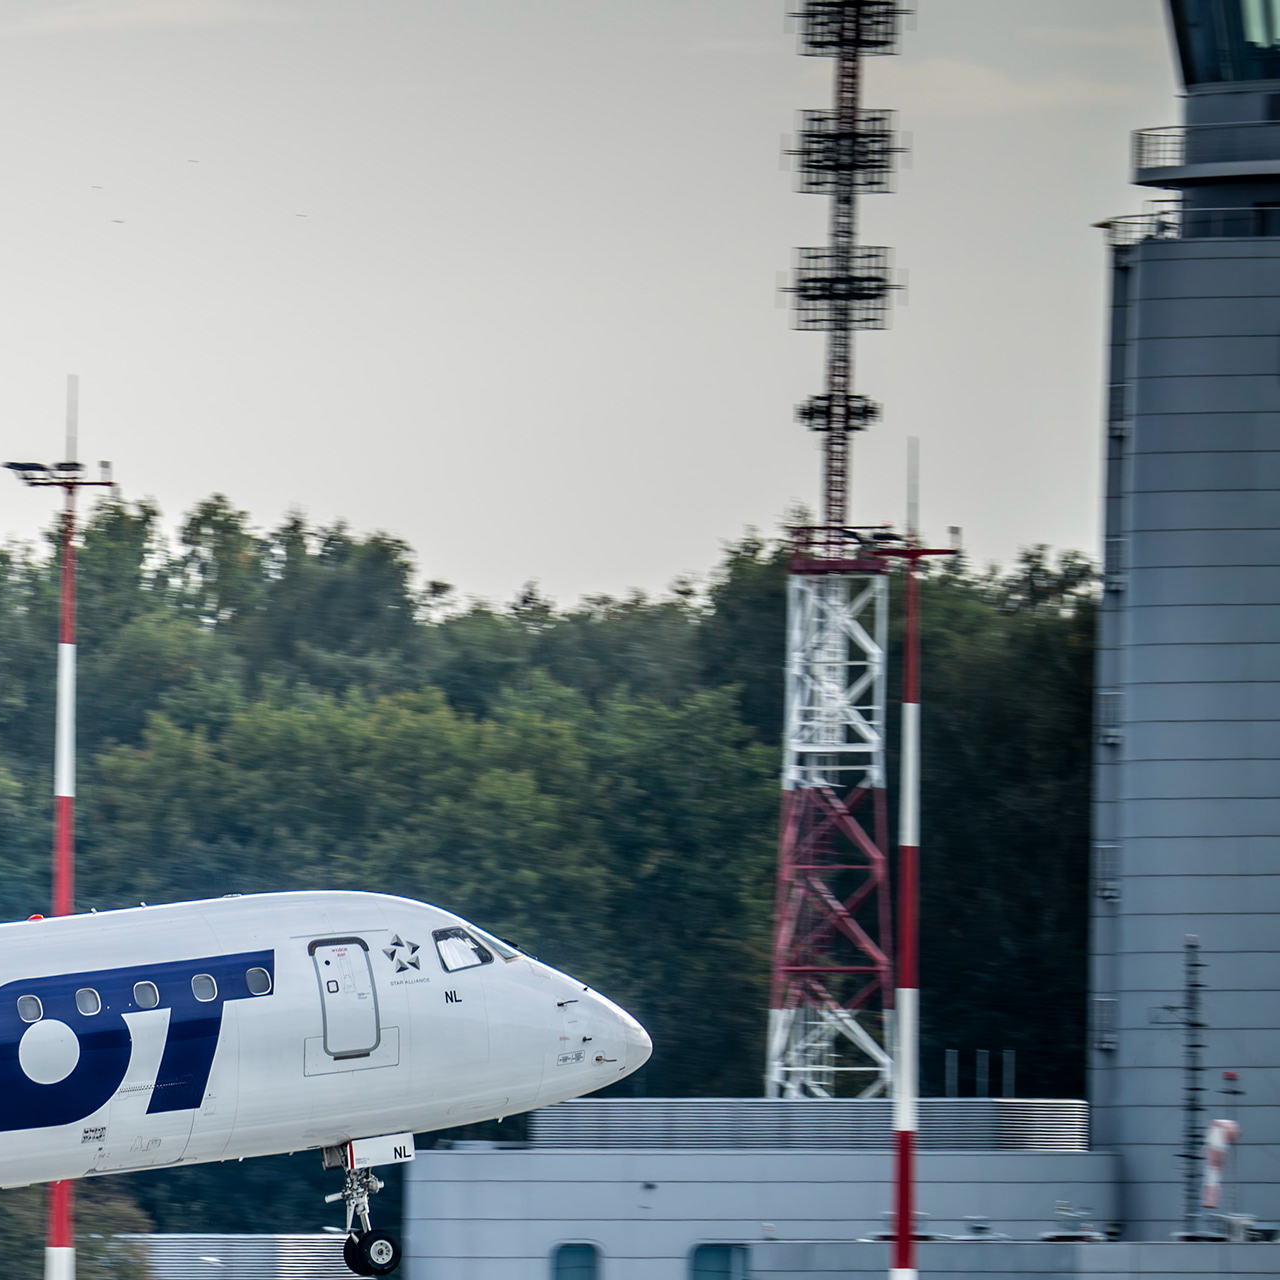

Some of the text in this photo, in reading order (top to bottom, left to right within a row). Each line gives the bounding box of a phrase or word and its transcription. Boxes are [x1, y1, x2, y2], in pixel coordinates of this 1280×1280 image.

[389, 977, 431, 987] STAR ALLIANCE
[444, 990, 463, 1004] NL
[393, 1145, 412, 1159] NL
